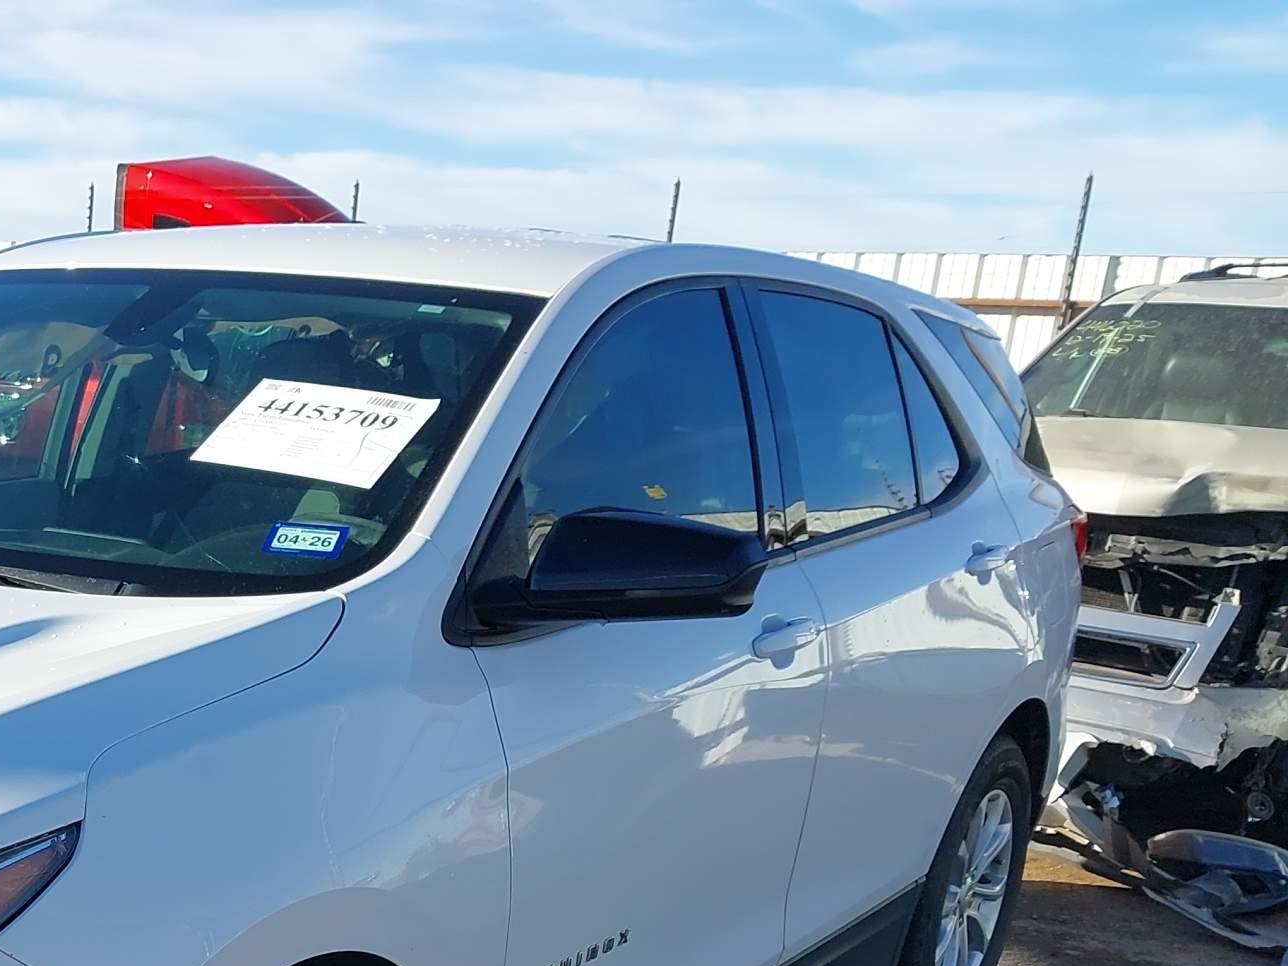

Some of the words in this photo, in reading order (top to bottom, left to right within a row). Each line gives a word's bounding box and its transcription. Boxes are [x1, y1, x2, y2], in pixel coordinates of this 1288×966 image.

[257, 398, 399, 430] 44153709
[276, 533, 299, 545] 04
[308, 535, 334, 548] 26
